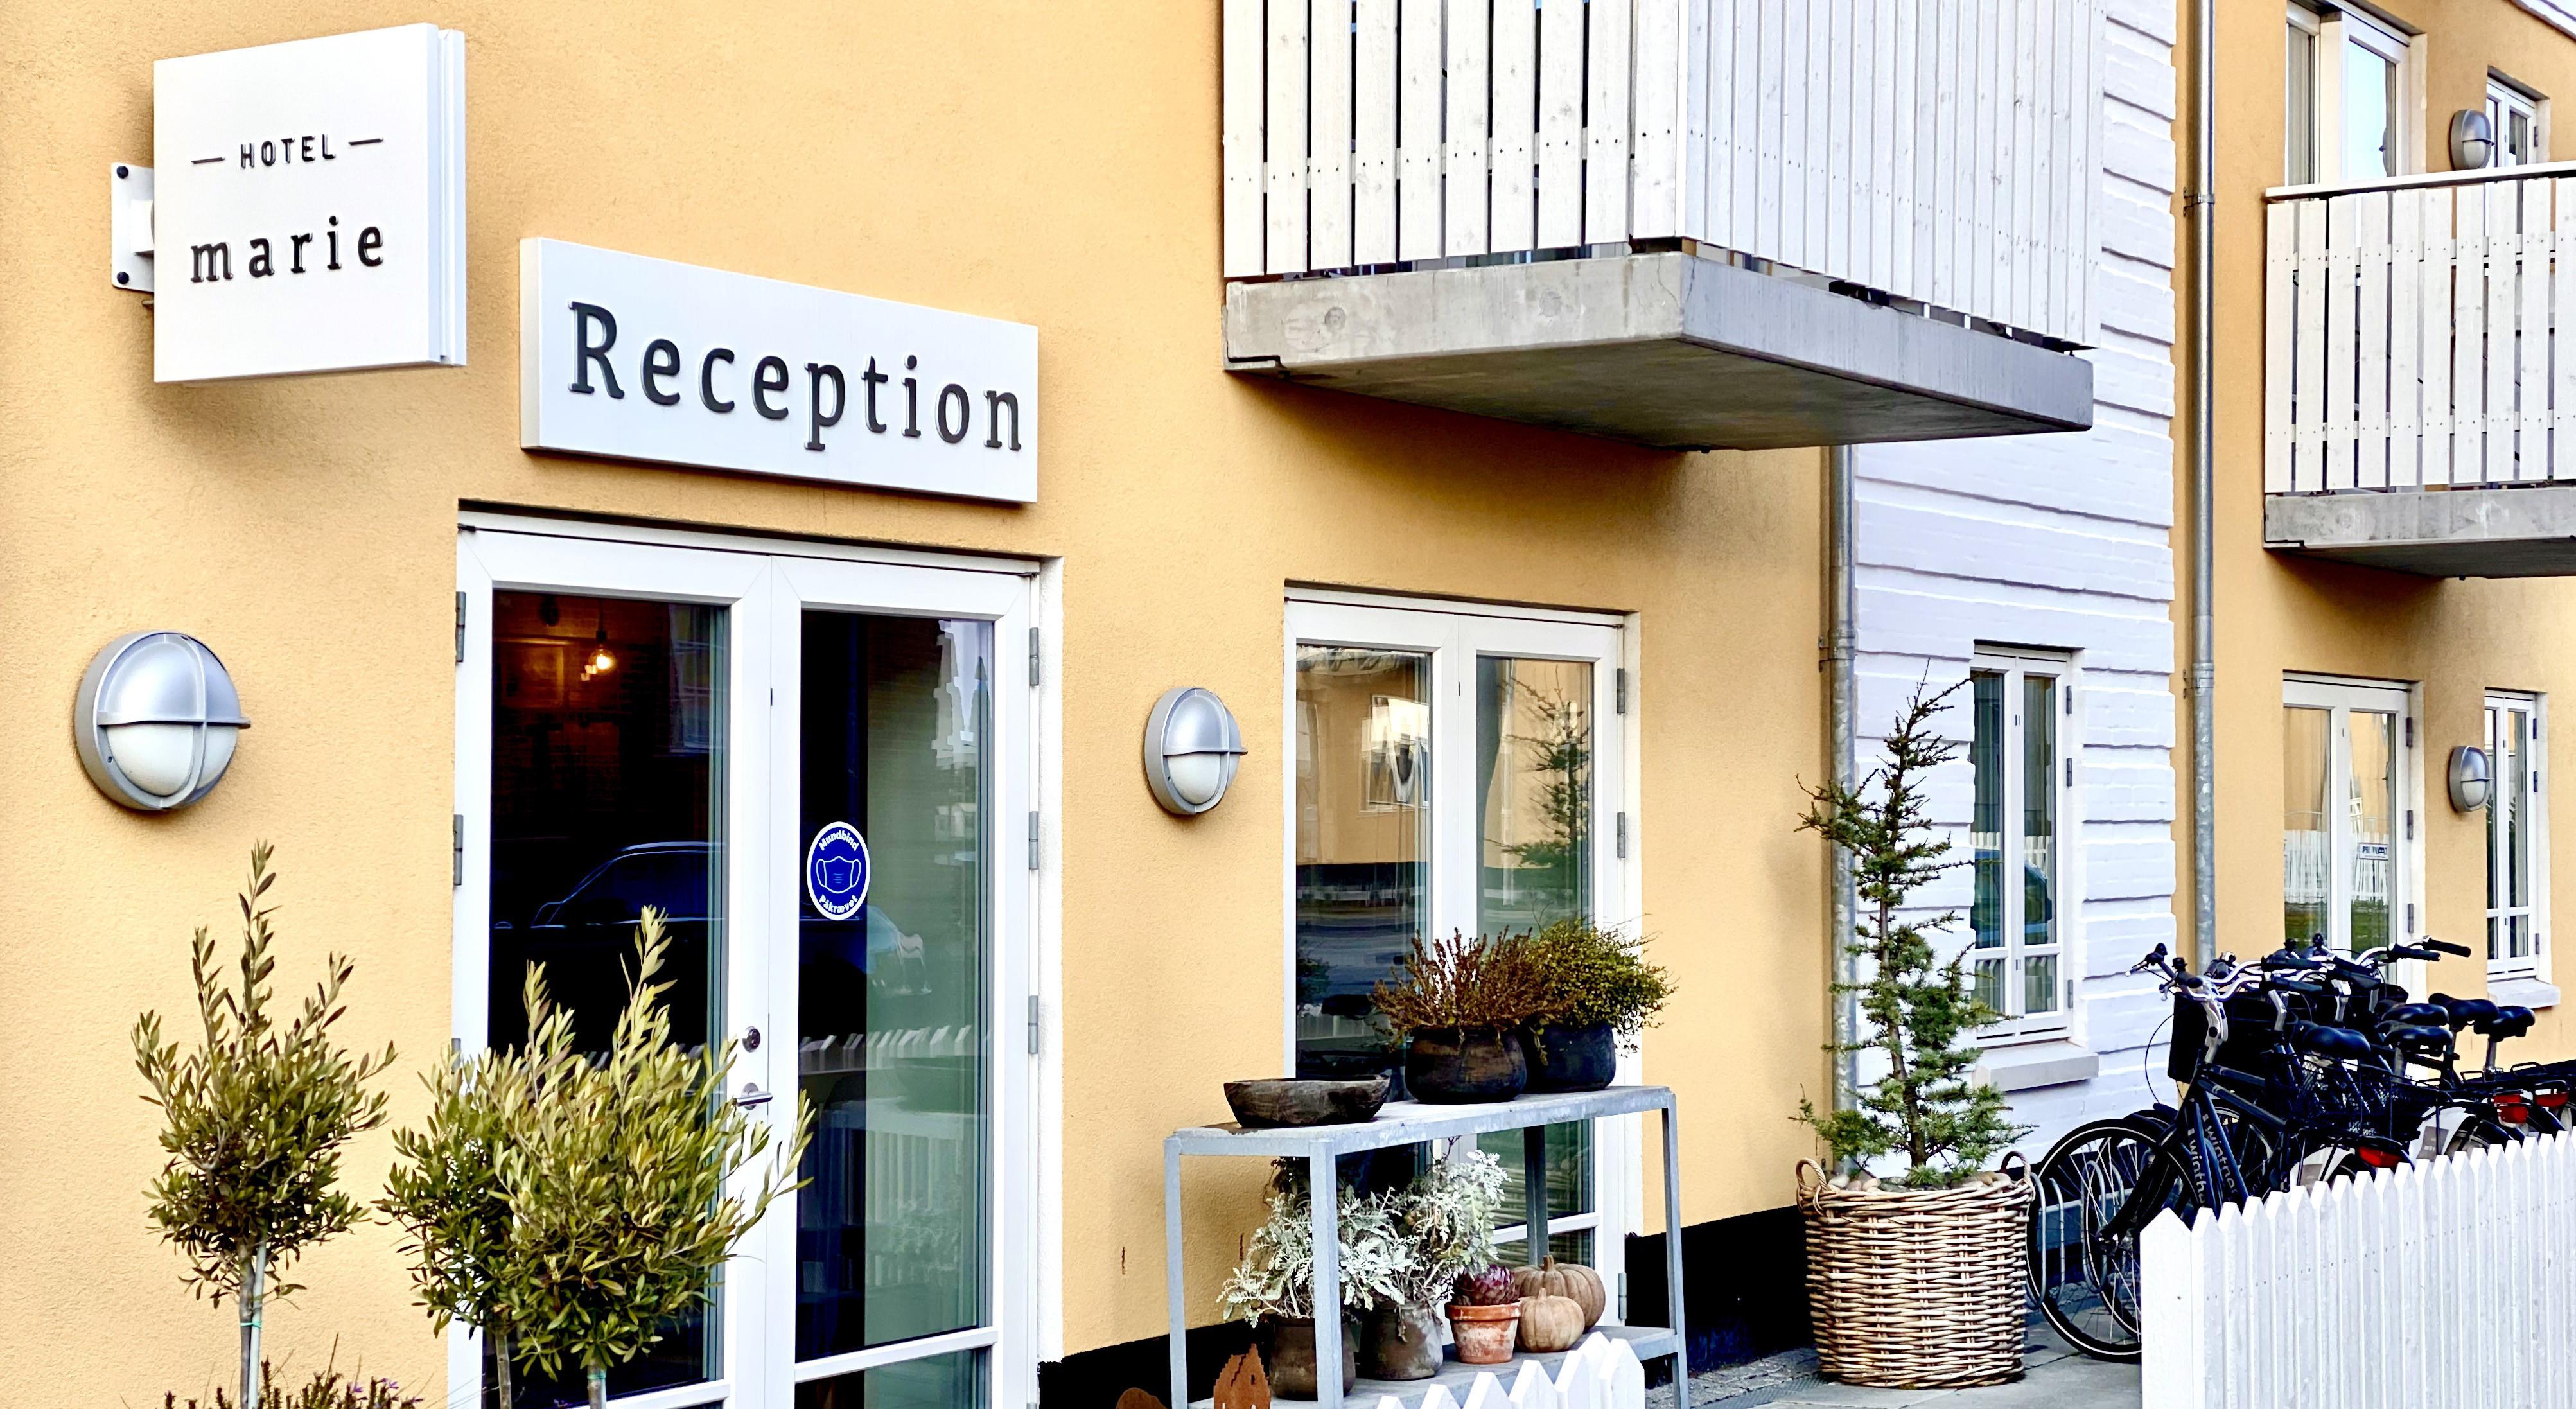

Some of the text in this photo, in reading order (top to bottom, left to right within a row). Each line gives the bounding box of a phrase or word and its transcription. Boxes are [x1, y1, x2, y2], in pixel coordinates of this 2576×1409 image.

[240, 134, 337, 169] HOTEL
[190, 216, 384, 283] marie
[567, 301, 1022, 451] Reception
[819, 829, 859, 852] Mundbind
[819, 894, 858, 914] Påkrævet
